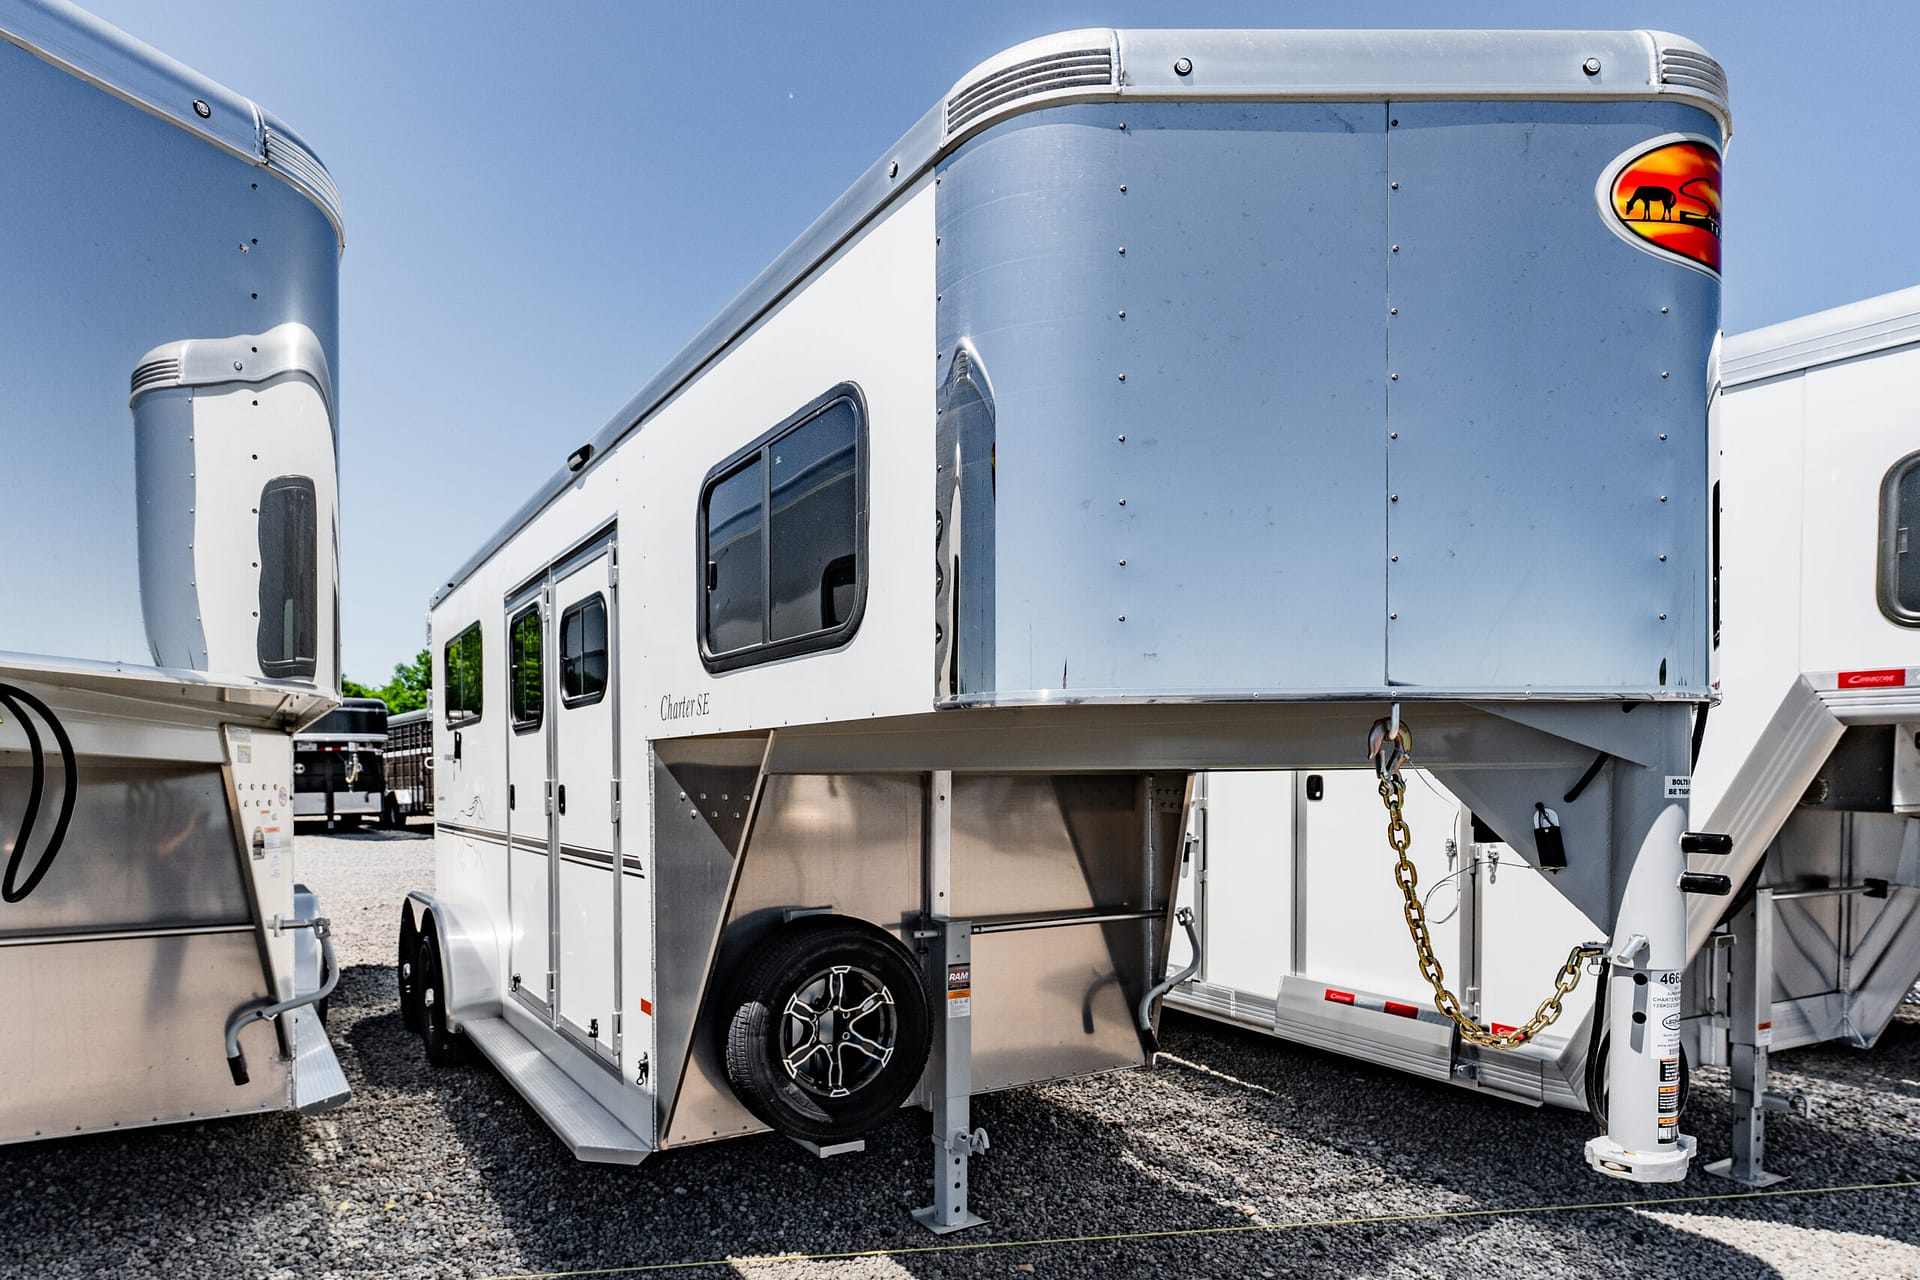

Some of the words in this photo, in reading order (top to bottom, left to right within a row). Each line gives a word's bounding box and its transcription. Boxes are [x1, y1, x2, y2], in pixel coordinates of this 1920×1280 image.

[660, 693, 695, 721] Charter
[696, 692, 710, 716] SE
[949, 971, 968, 981] RAM
[1660, 973, 1681, 985] 466
